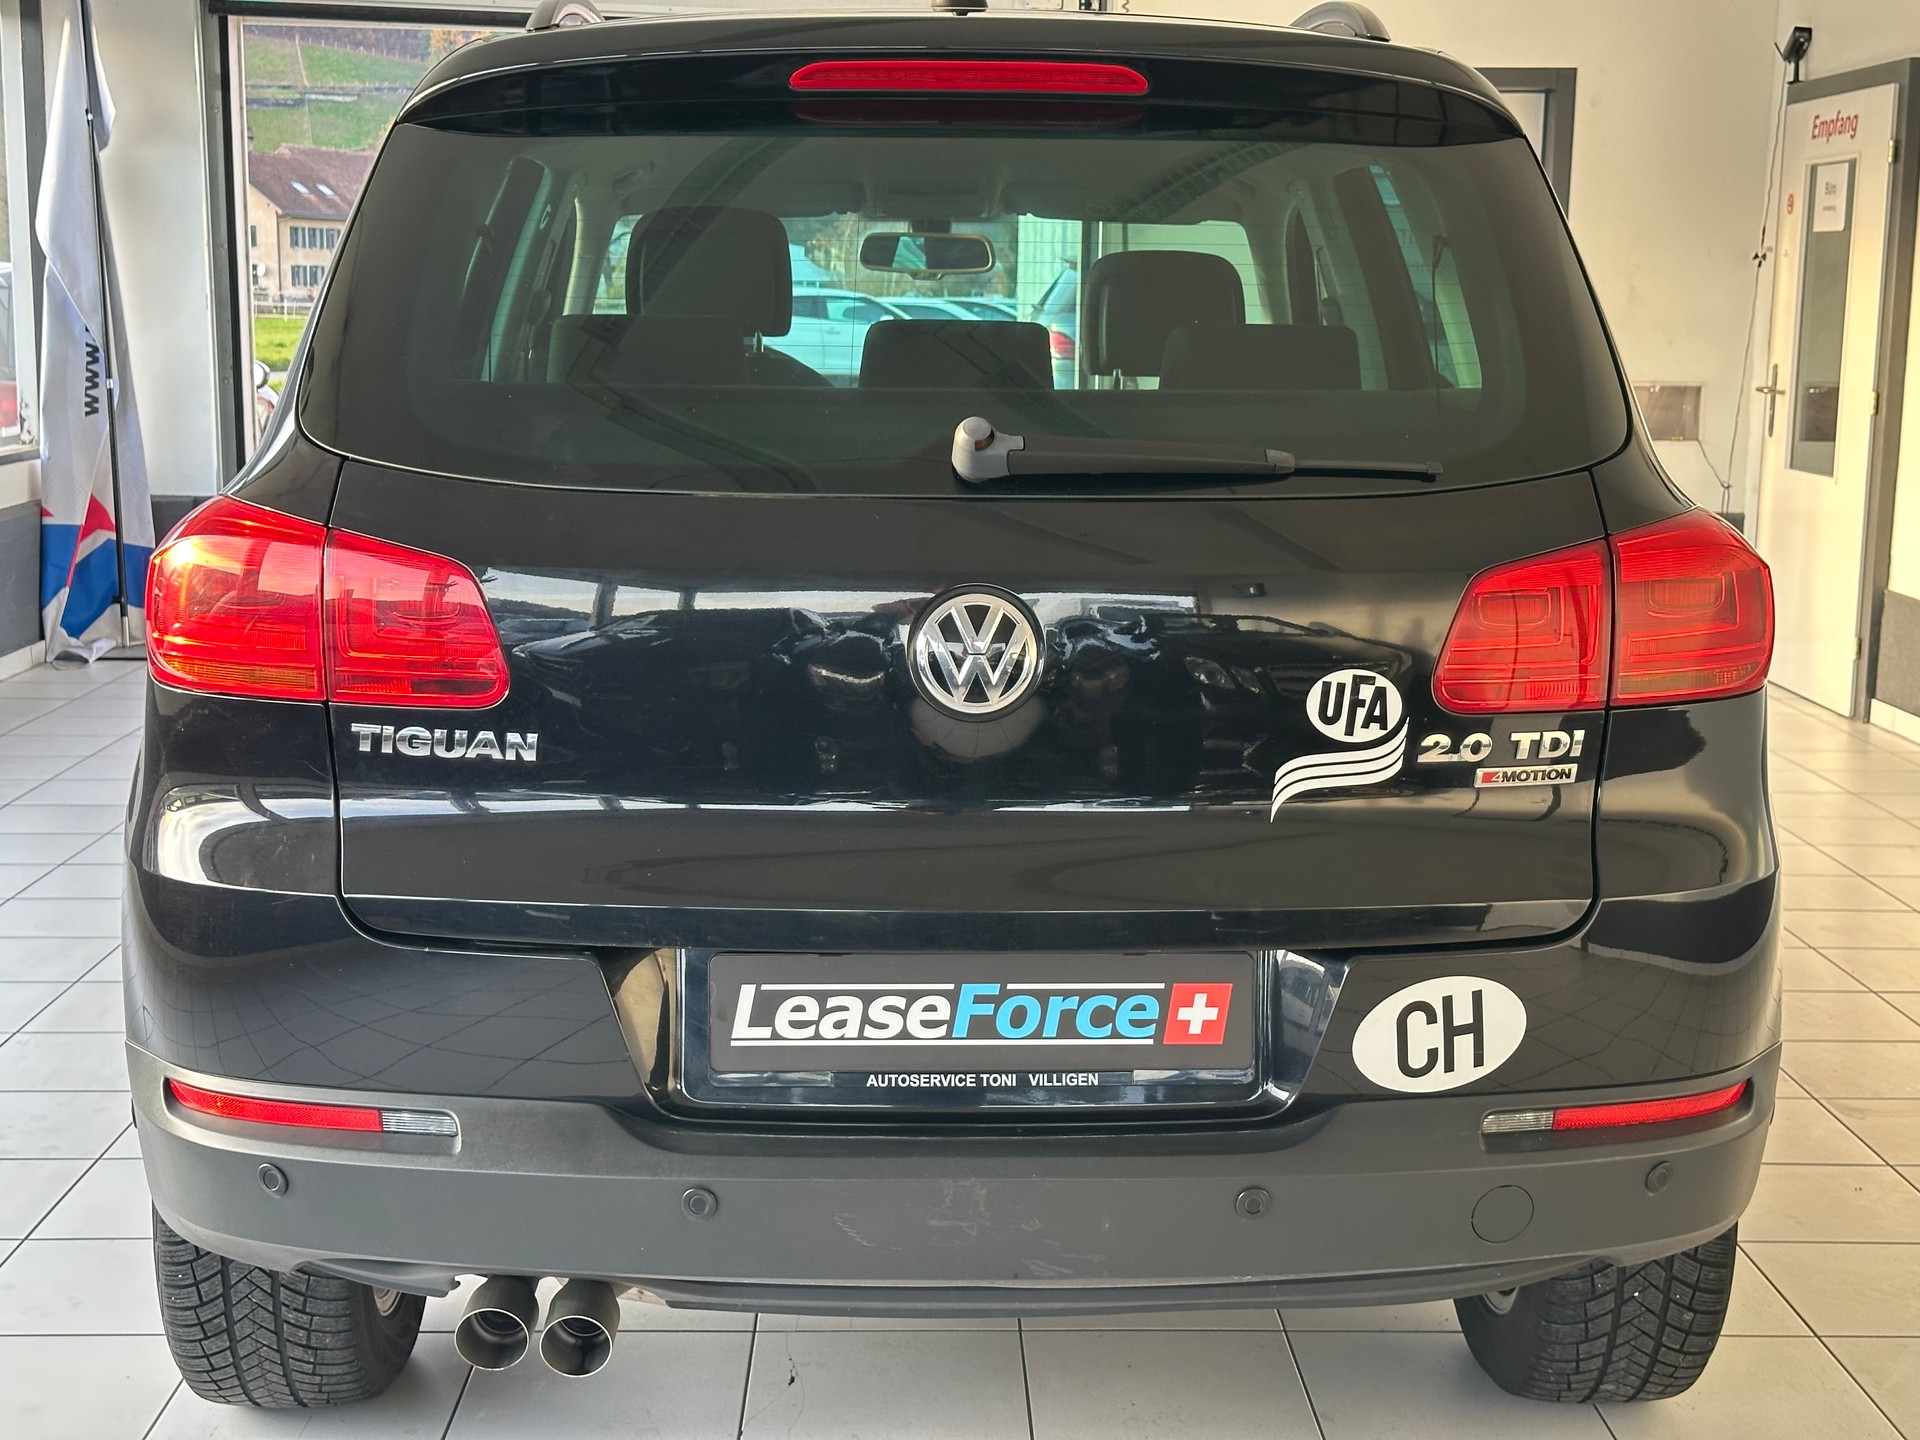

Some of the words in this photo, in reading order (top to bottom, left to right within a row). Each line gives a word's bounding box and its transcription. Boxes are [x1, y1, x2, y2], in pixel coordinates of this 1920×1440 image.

[1811, 109, 1859, 143] Empfang
[916, 593, 1038, 714] VW
[1317, 674, 1389, 737] UFA
[350, 722, 539, 762] TIGUAN
[1416, 732, 1494, 763] 2.0
[1510, 729, 1586, 760] TDI
[1481, 767, 1573, 784] 4MOTION
[730, 983, 1160, 1040] LeaseForce
[1396, 988, 1485, 1079] CH
[866, 1073, 977, 1088] AUTOSERVICE
[980, 1073, 1017, 1087] TONI
[1028, 1072, 1099, 1087] VILLIGEN
